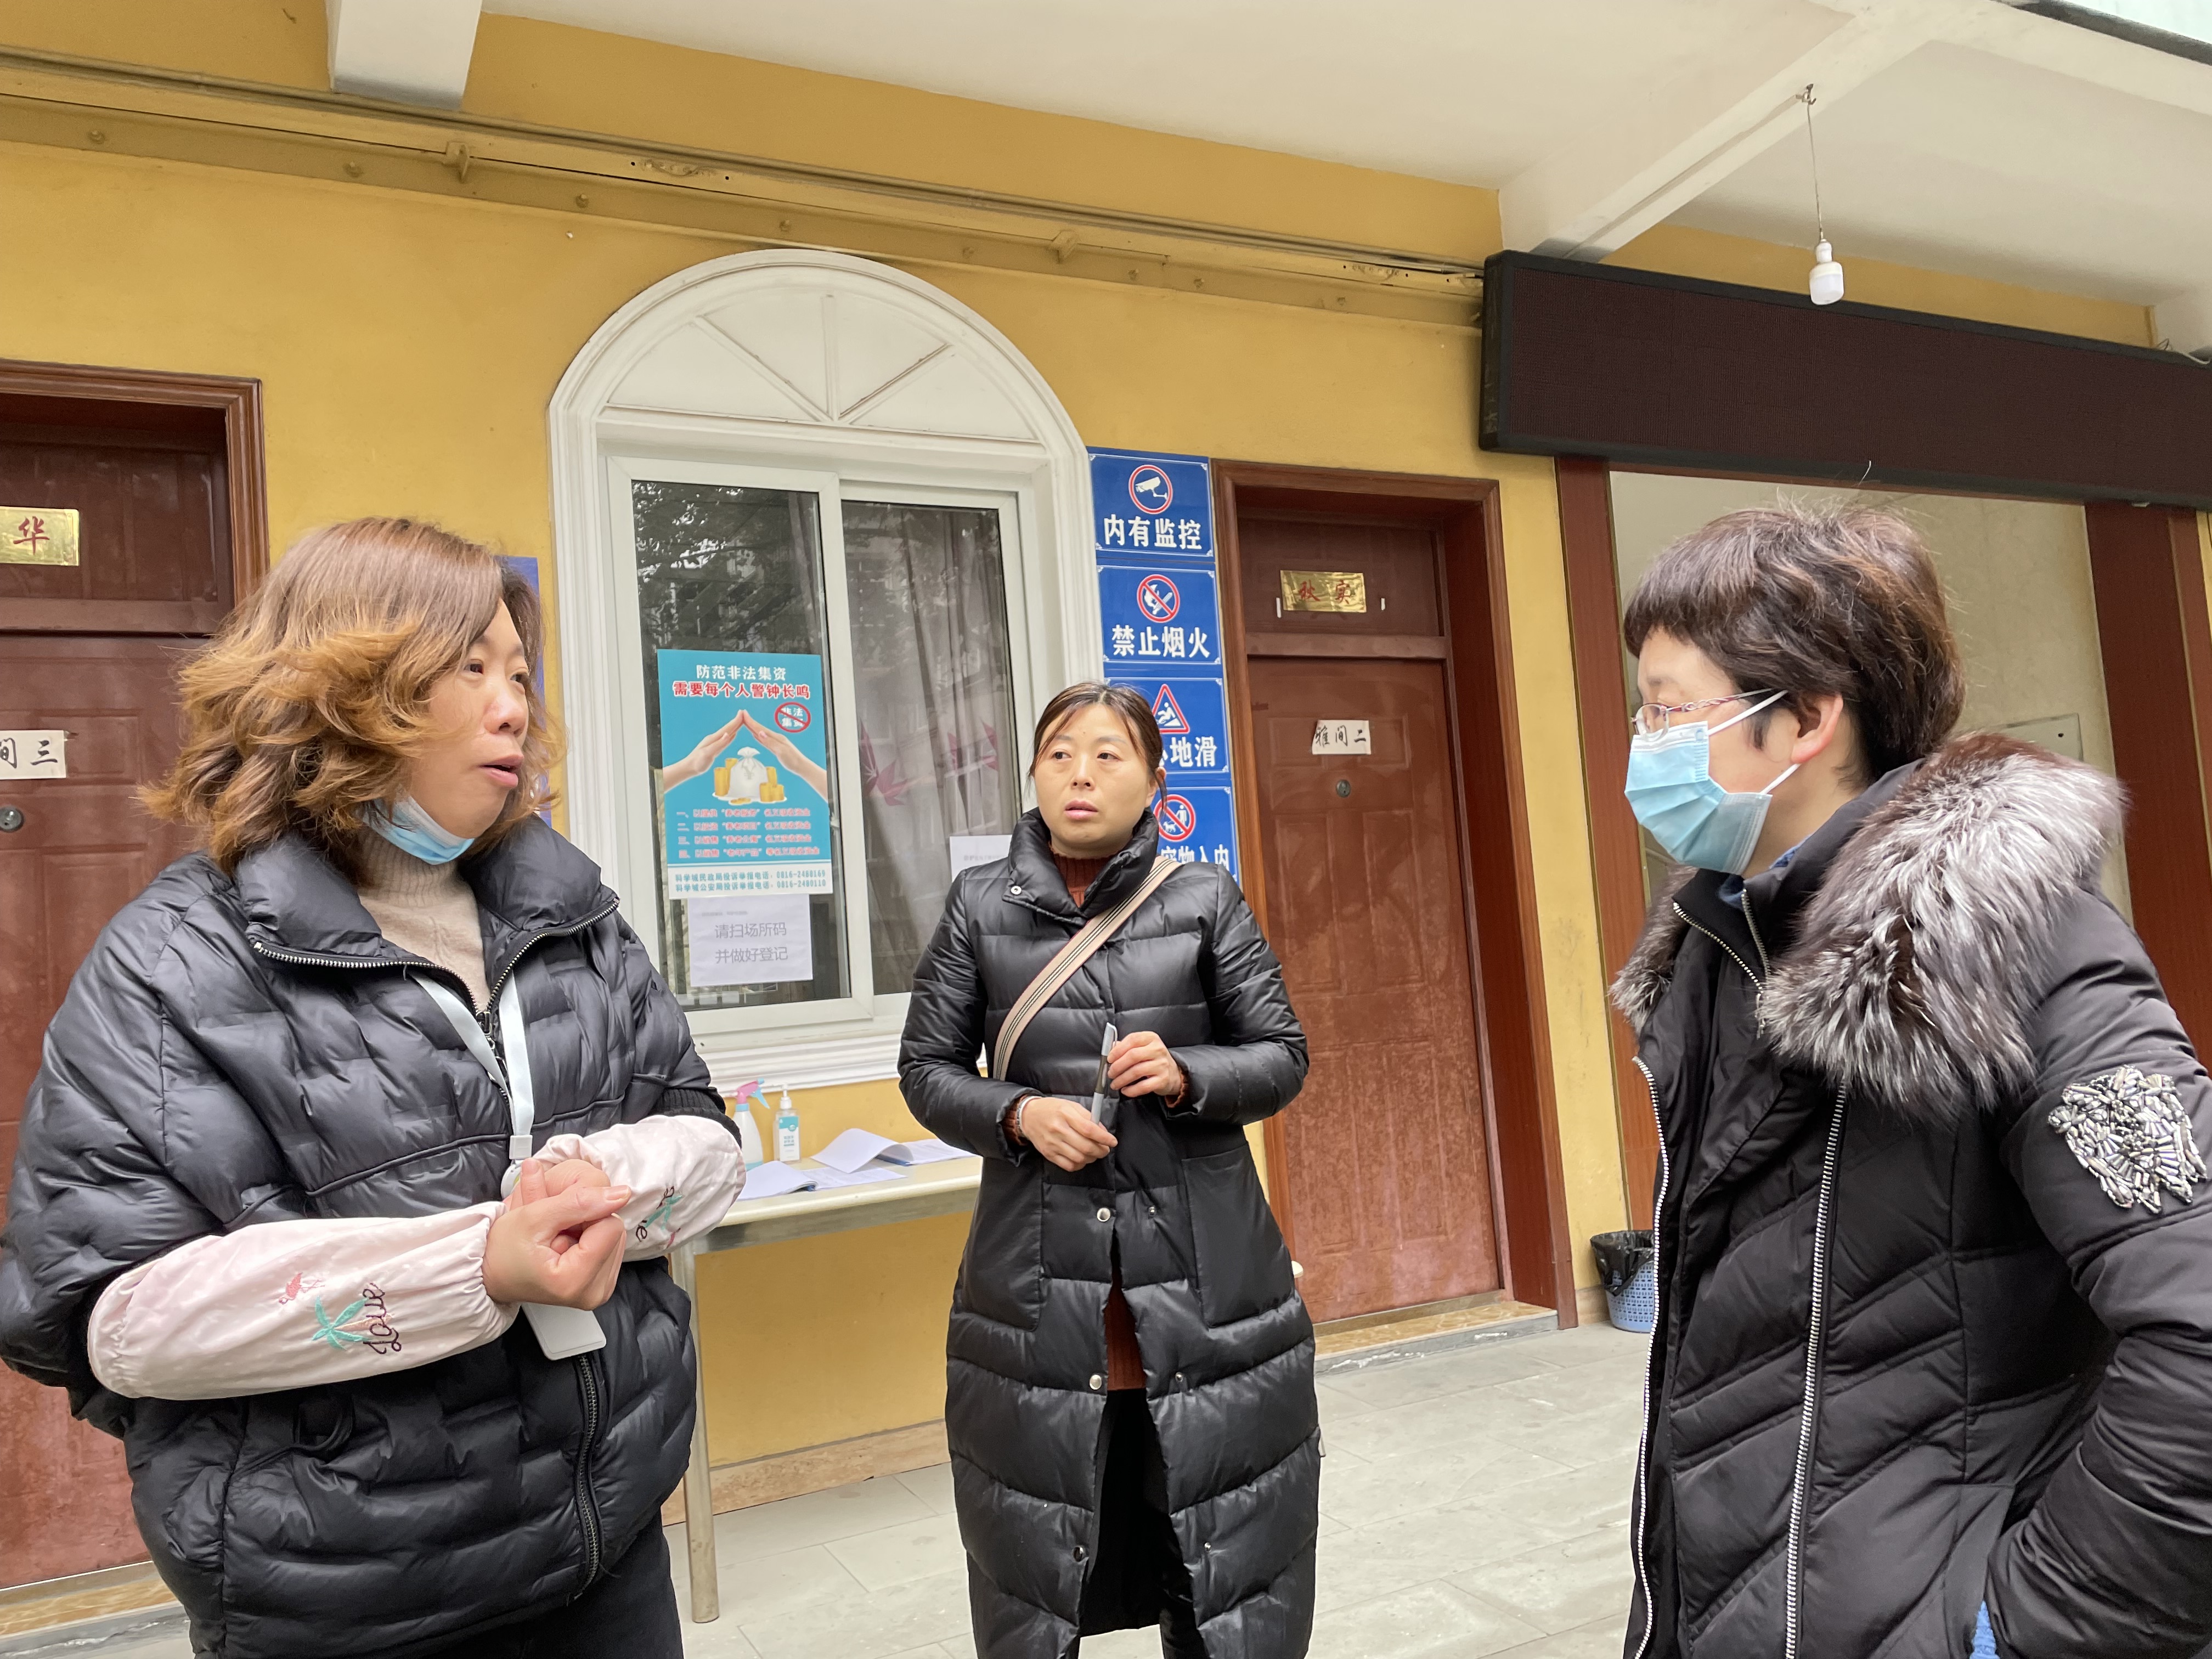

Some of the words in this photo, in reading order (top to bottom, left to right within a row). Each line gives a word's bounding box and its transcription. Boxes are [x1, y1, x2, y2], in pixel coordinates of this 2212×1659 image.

[13, 516, 50, 556] 华
[1103, 514, 1203, 549] 内有监控
[1112, 624, 1210, 658] 禁止烟火
[696, 664, 787, 681] 防范非法集资
[673, 680, 810, 699] 需要每个人警钟长鸣
[714, 922, 787, 939] 请扫场所码
[715, 946, 788, 964] 并做好登记
